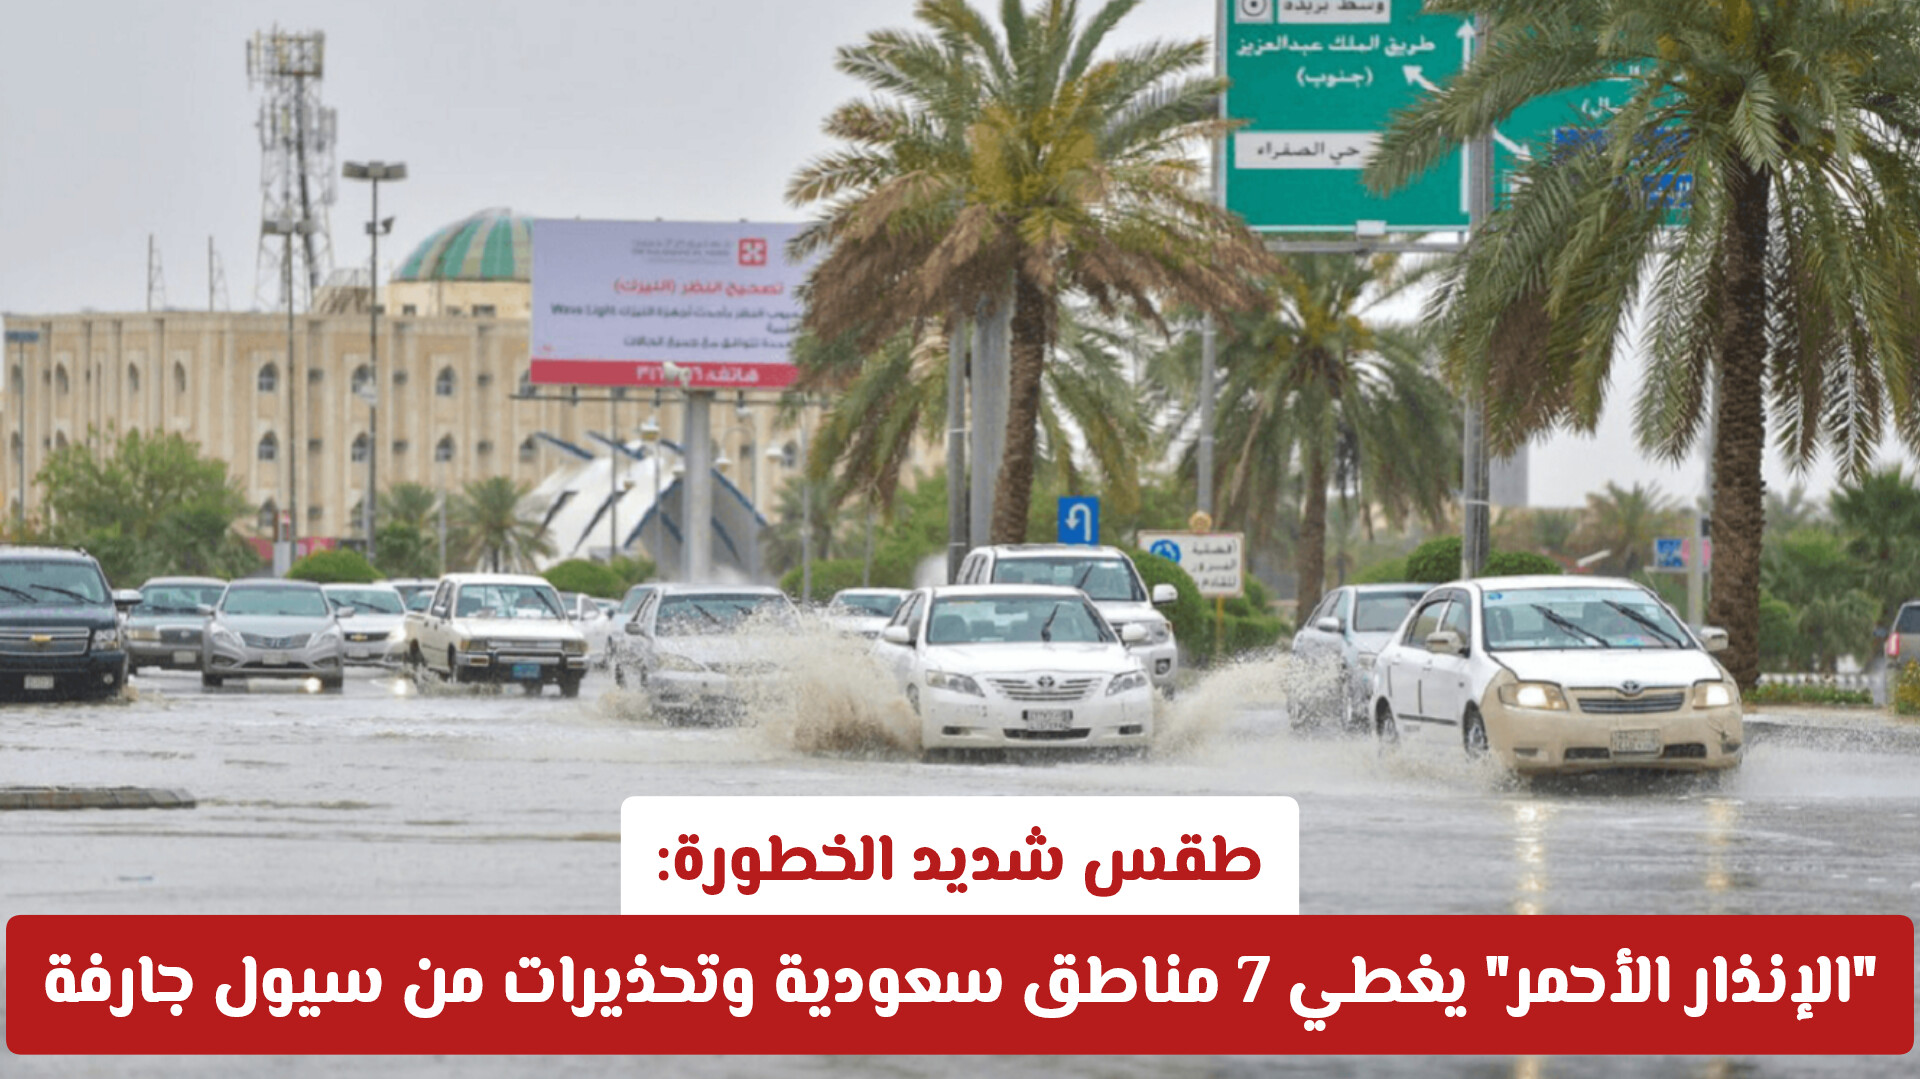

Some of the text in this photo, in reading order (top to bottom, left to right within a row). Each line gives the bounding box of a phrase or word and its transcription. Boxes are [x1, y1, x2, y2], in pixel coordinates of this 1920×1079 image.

[1237, 34, 1436, 57] طريق الملك عبدالعزيز
[1296, 67, 1374, 88] (جنوب)
[1257, 141, 1361, 165] حي الصفراء
